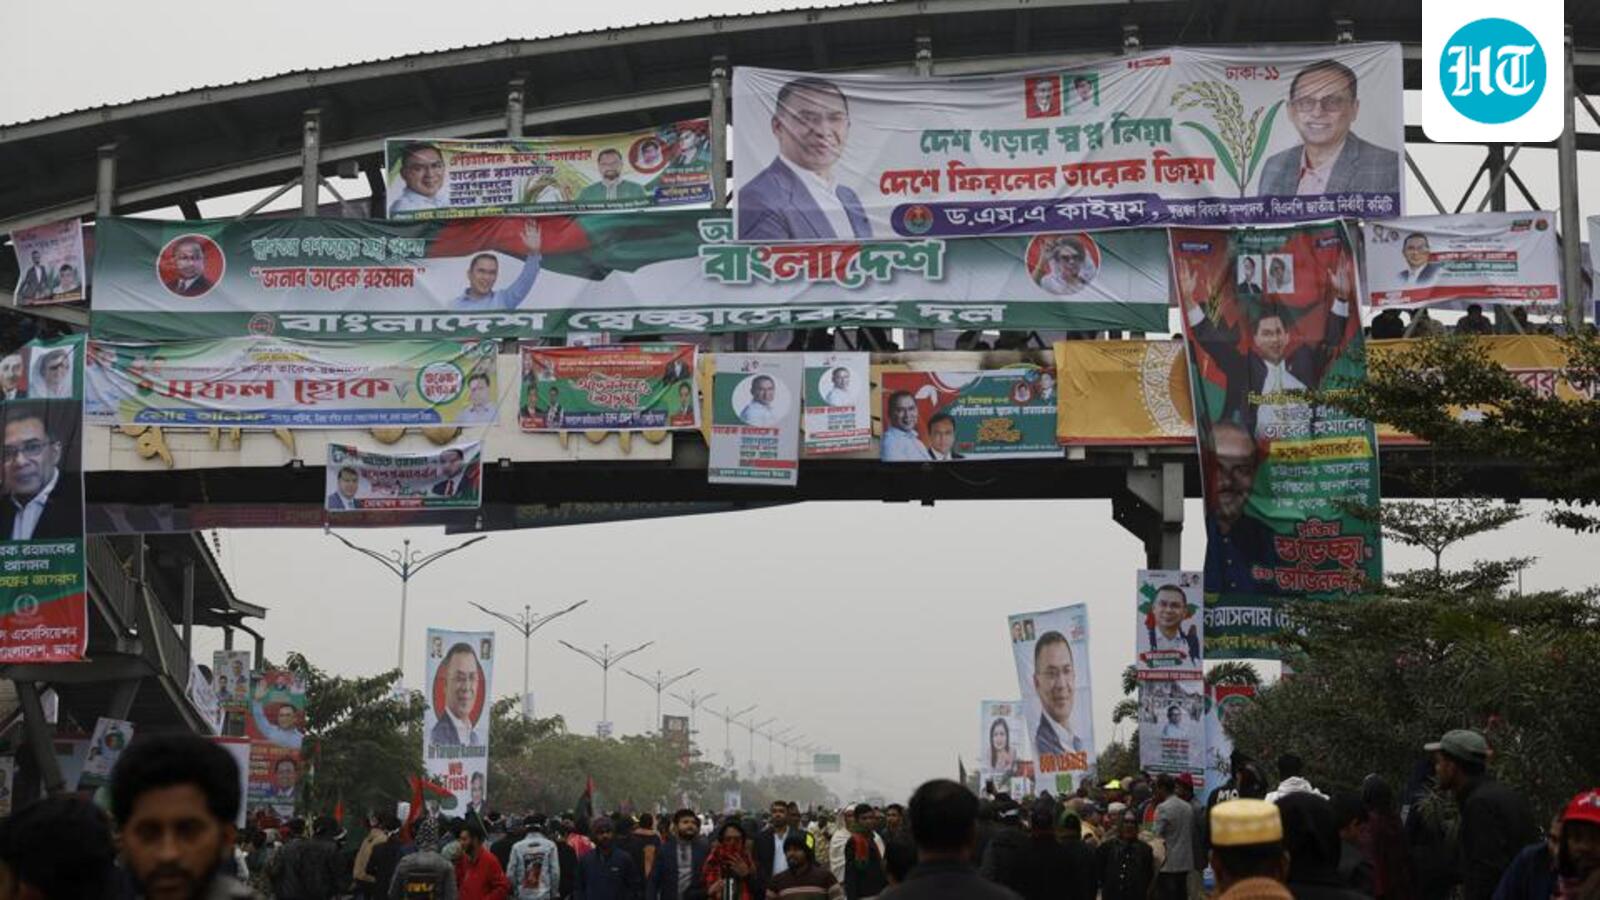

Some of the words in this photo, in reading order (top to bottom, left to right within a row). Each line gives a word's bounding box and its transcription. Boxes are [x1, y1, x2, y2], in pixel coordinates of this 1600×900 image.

[1225, 66, 1280, 81] ঢাকা-১১
[920, 128, 972, 154] দেশ
[979, 127, 1050, 160] গড়ার
[1055, 121, 1105, 152] স্বপ্ন
[1111, 112, 1173, 147] নিয়া
[879, 168, 941, 196] দেশে
[947, 160, 1057, 196] ফিরলেন
[1061, 158, 1147, 190] তারেক
[1152, 149, 1216, 186] জিয়া
[944, 205, 1047, 227] ড.এম.এ
[1271, 197, 1303, 215] বিএনপি
[1367, 195, 1394, 212] কমিটি
[308, 267, 361, 291] তারেক
[700, 239, 946, 288] বাংলাদেশ
[279, 312, 548, 334] বাংলাদেশ
[567, 303, 899, 332] স্বেচ্ছাসেবক
[915, 303, 1007, 324] দল
[294, 377, 390, 405] হোক
[1274, 537, 1364, 568] শুভেচ্ছা
[1214, 606, 1272, 628] আসলাম
